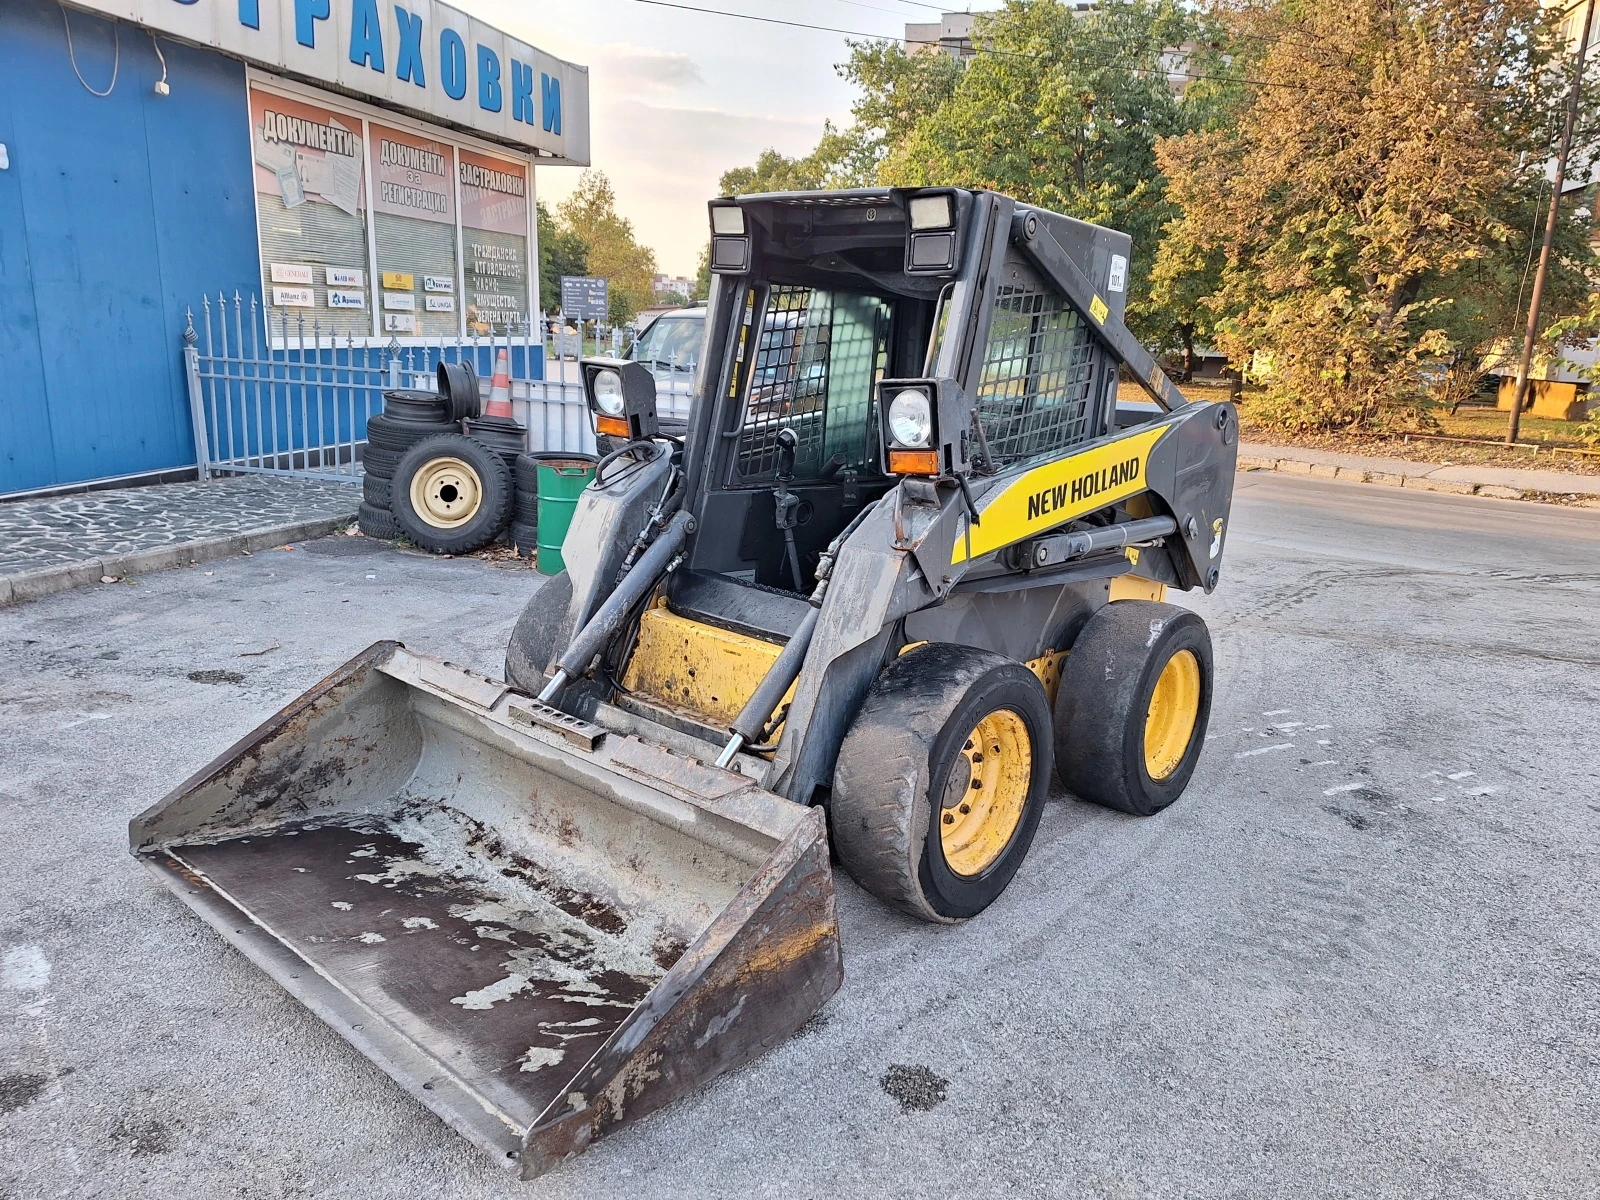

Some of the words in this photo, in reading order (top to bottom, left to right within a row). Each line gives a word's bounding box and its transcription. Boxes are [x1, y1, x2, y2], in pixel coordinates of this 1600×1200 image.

[263, 109, 354, 157] ДОКУМЕНТИ
[380, 138, 445, 177] ДОКУМЕНТИ
[381, 181, 447, 214] РЕГИСТРАЦИЯ
[460, 162, 525, 198] ЗАСТРАХОВКИ
[280, 291, 300, 300] Allianz
[1027, 482, 1068, 521] NEW
[1070, 456, 1140, 504] HOLLAND
